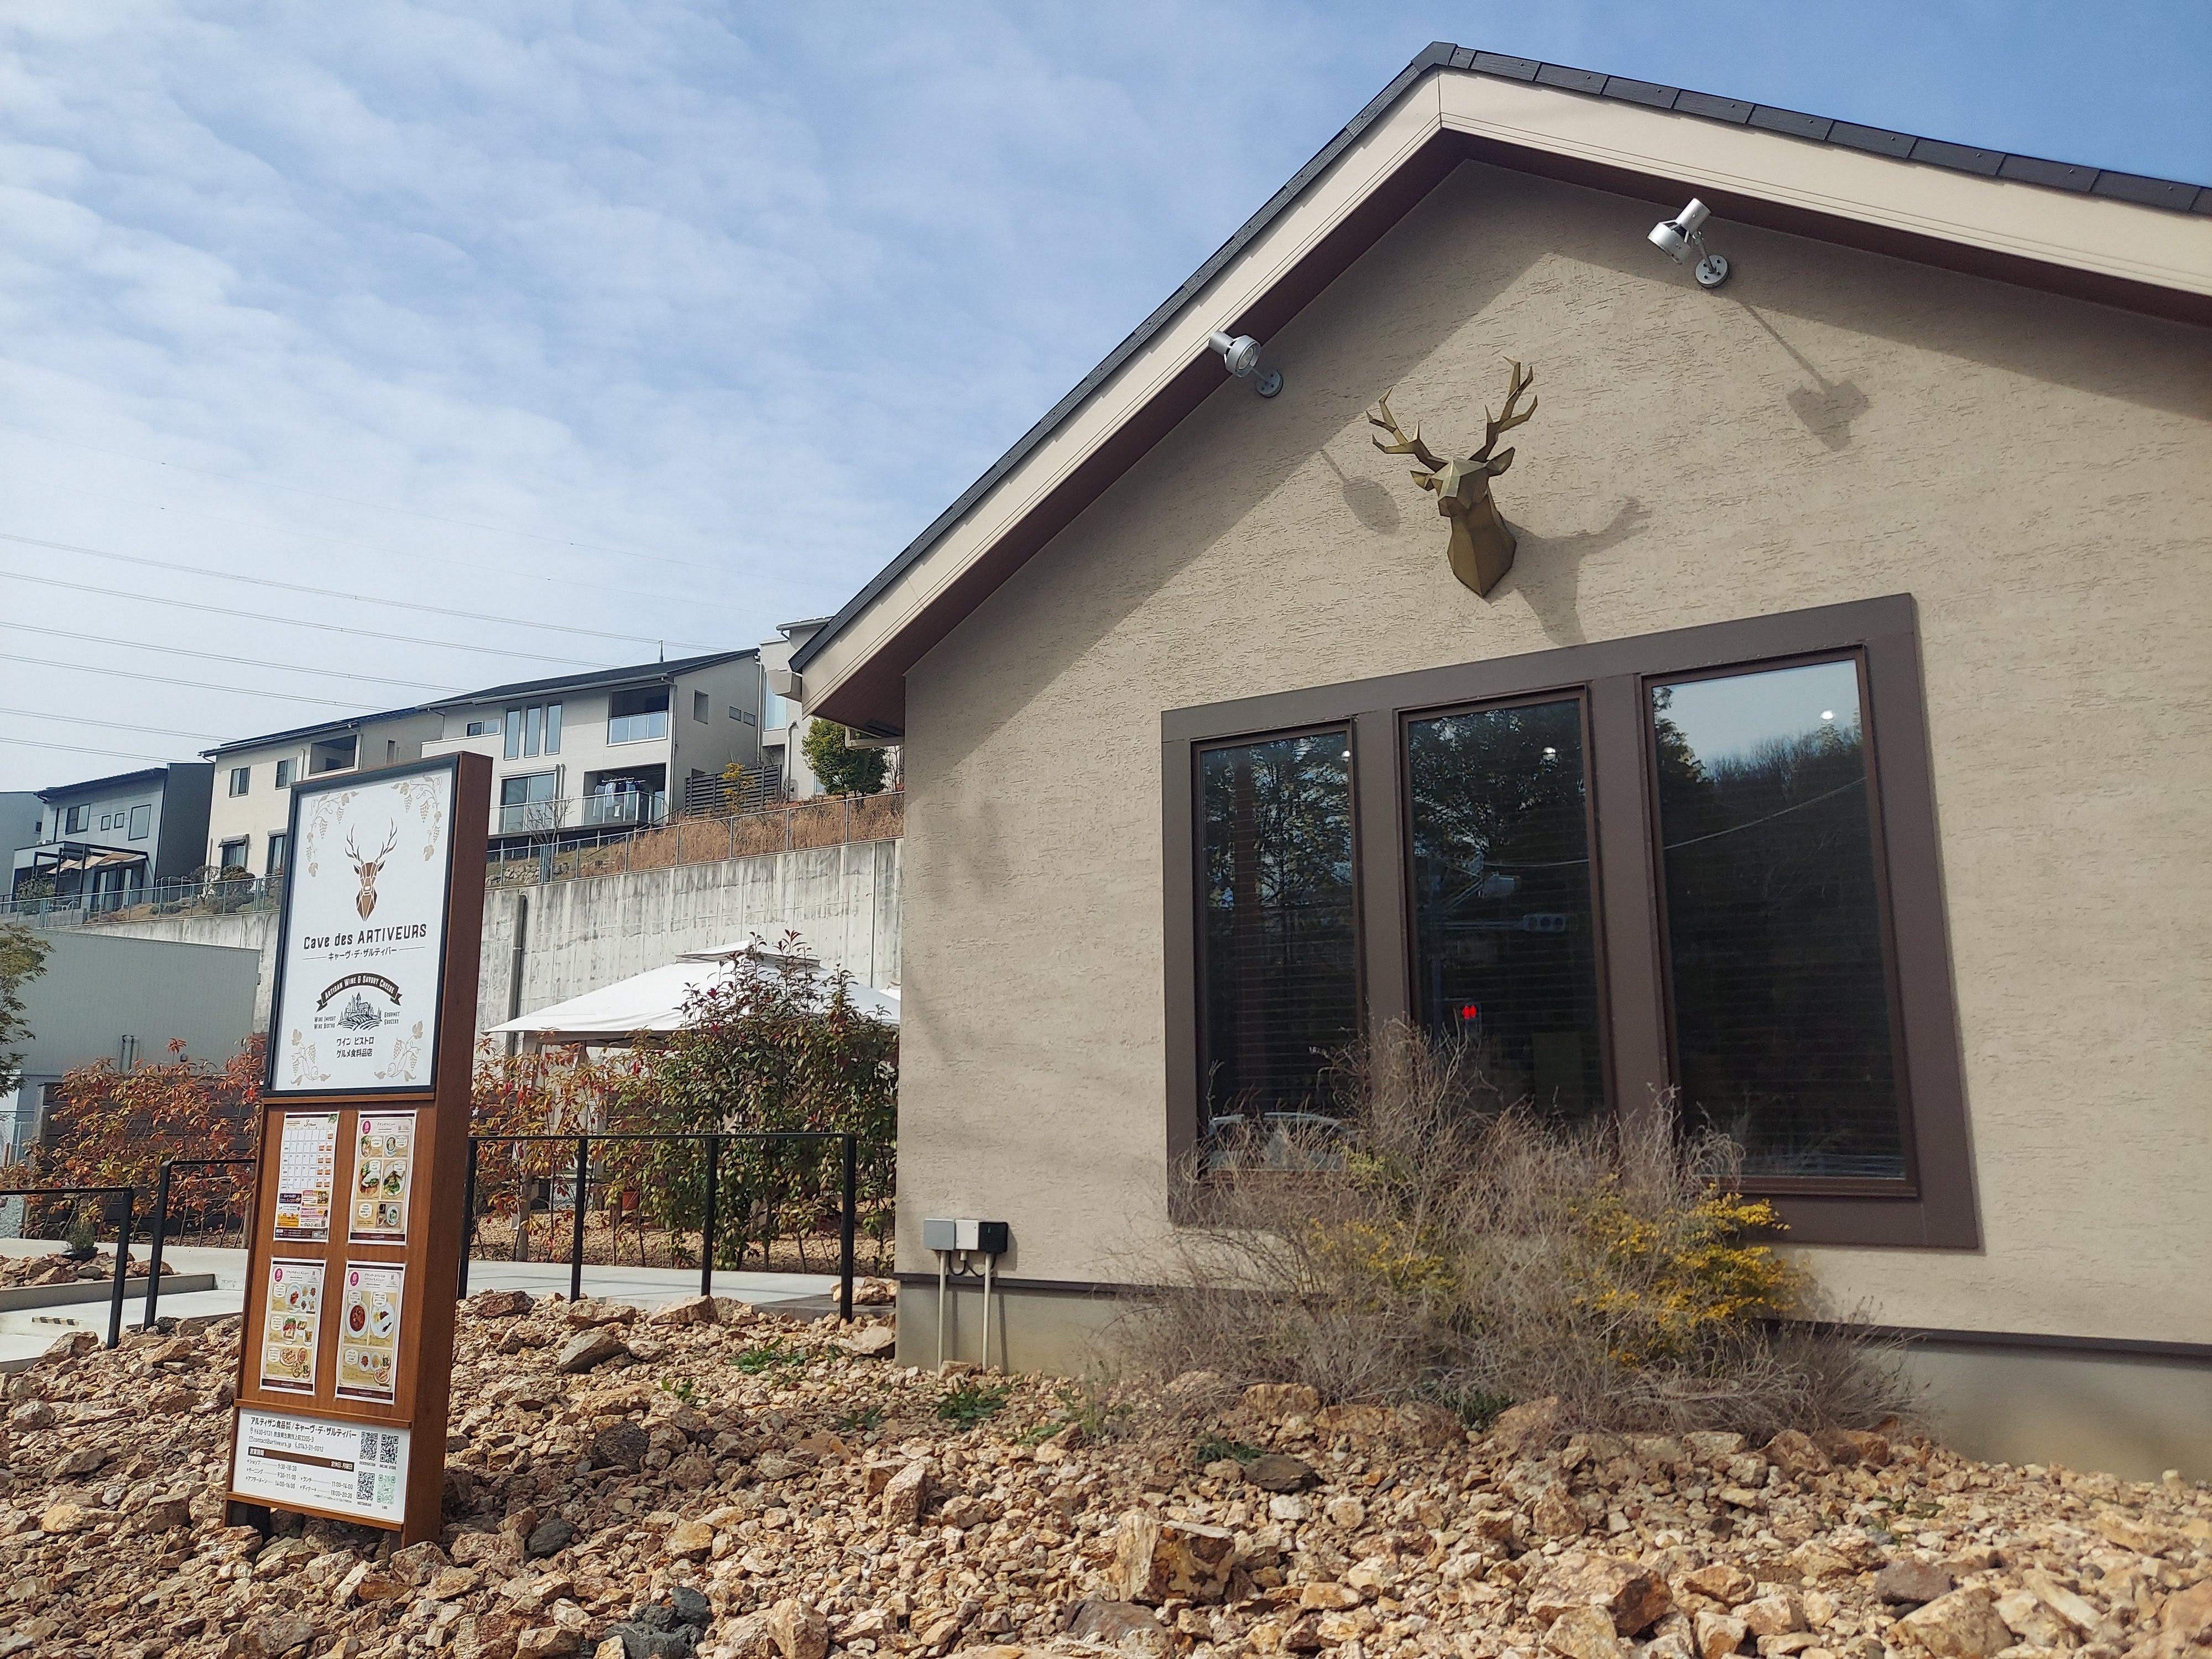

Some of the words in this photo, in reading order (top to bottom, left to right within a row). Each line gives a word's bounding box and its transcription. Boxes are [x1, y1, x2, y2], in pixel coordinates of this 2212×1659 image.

[304, 936, 330, 950] Cave
[335, 933, 353, 946] des
[357, 924, 427, 944] ARTIVEURS
[336, 1038, 351, 1046] ワイン
[336, 1048, 373, 1058] グルメ食料品店
